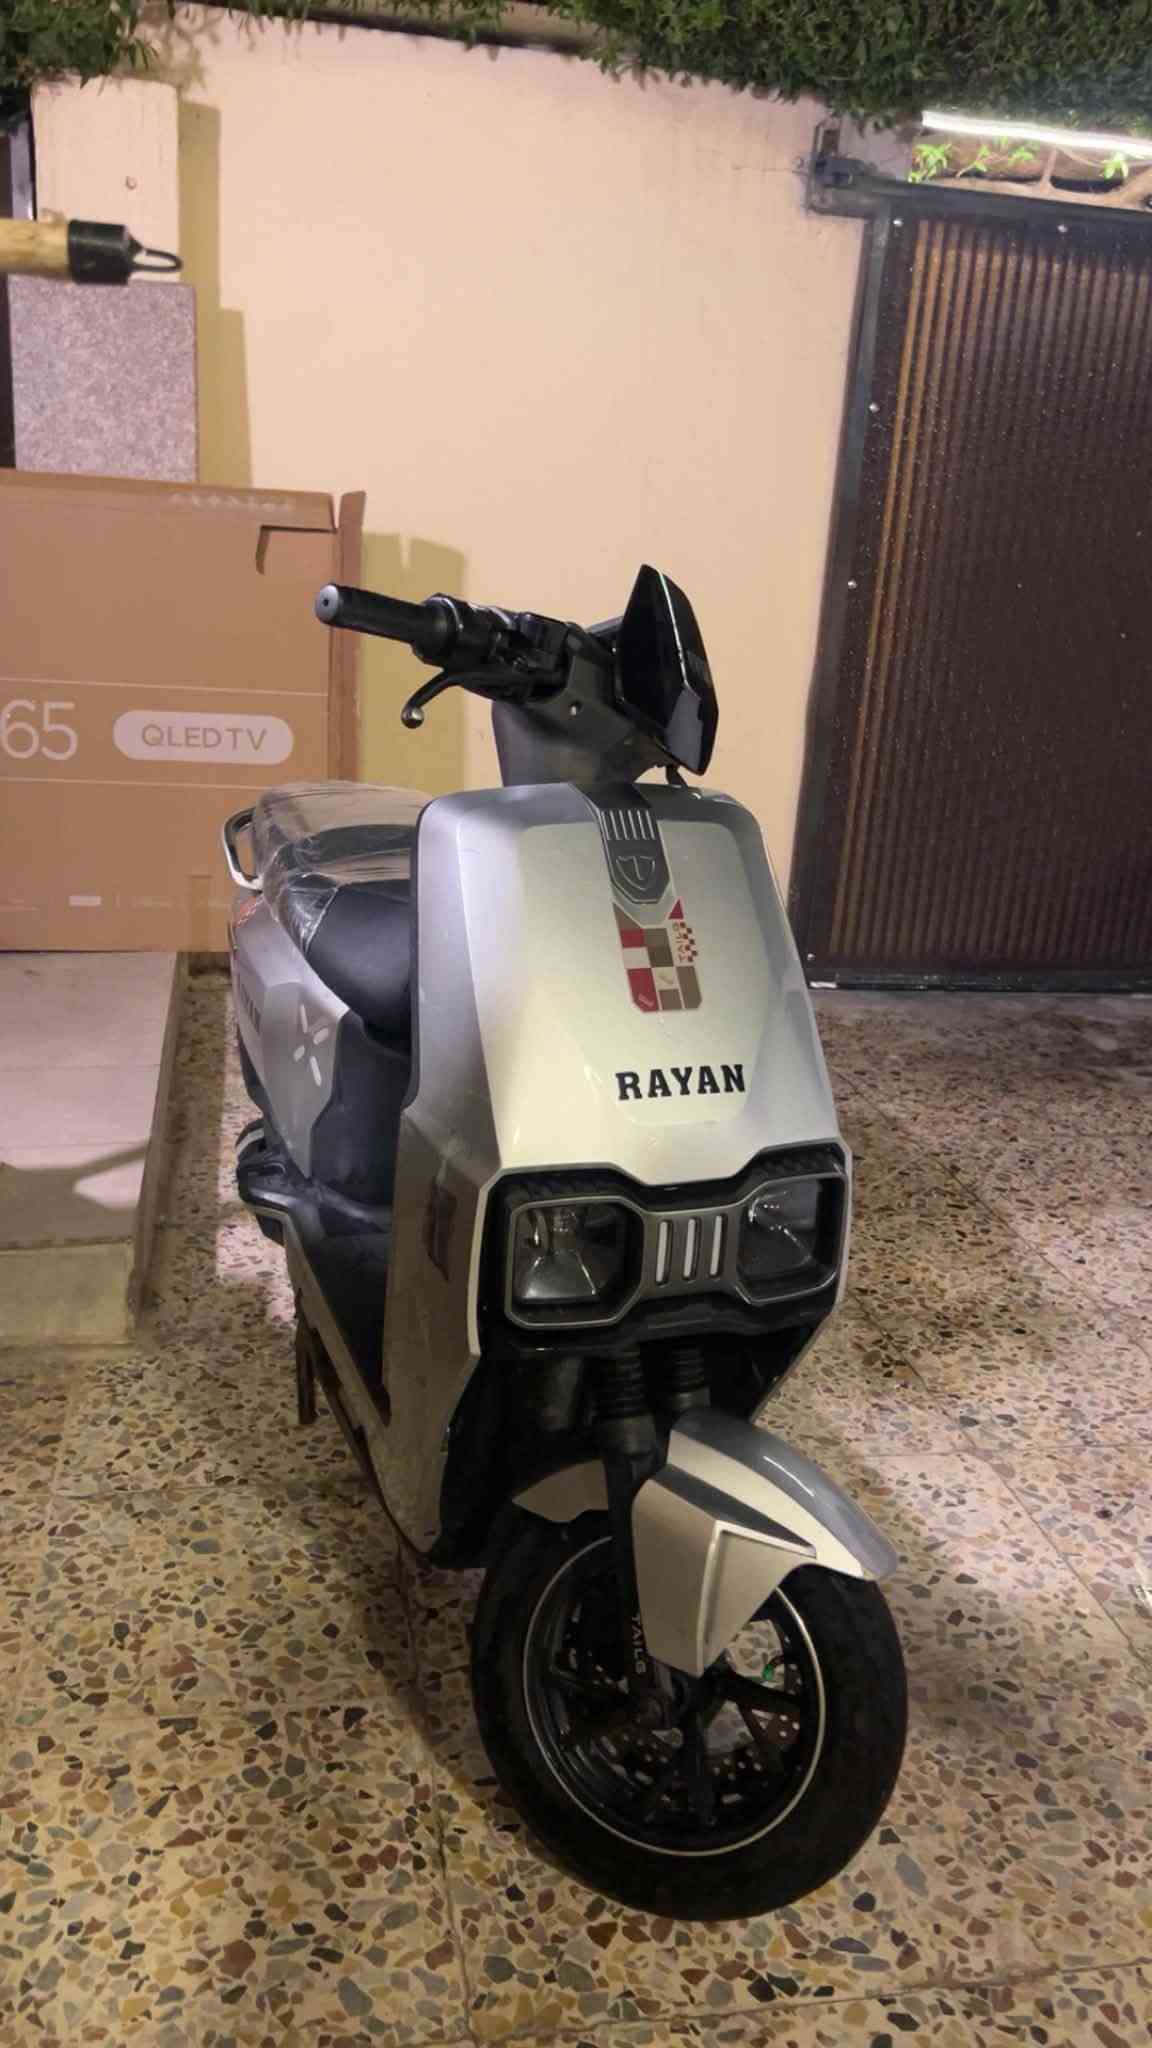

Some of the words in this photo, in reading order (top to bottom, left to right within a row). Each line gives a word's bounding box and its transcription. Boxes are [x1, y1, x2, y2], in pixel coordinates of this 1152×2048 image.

[0, 699, 78, 760] 65
[141, 724, 222, 749] QLED
[226, 728, 268, 751] TV
[615, 1064, 745, 1100] RAYAN
